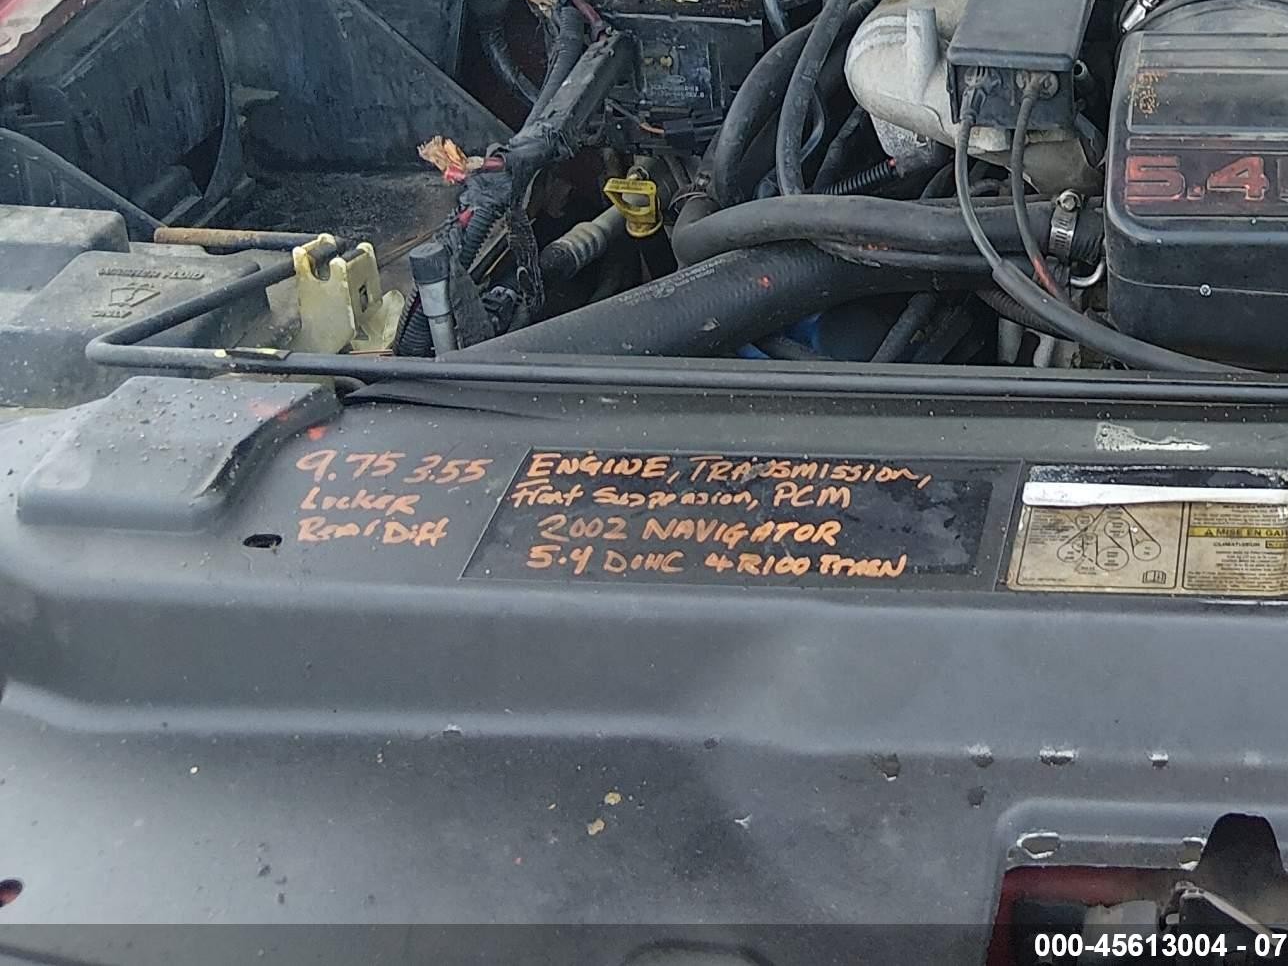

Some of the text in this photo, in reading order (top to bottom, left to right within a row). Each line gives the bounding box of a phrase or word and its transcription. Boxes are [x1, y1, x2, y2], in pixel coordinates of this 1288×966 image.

[773, 482, 851, 509] PCM
[536, 513, 843, 550] 2002 NAVIGATOR
